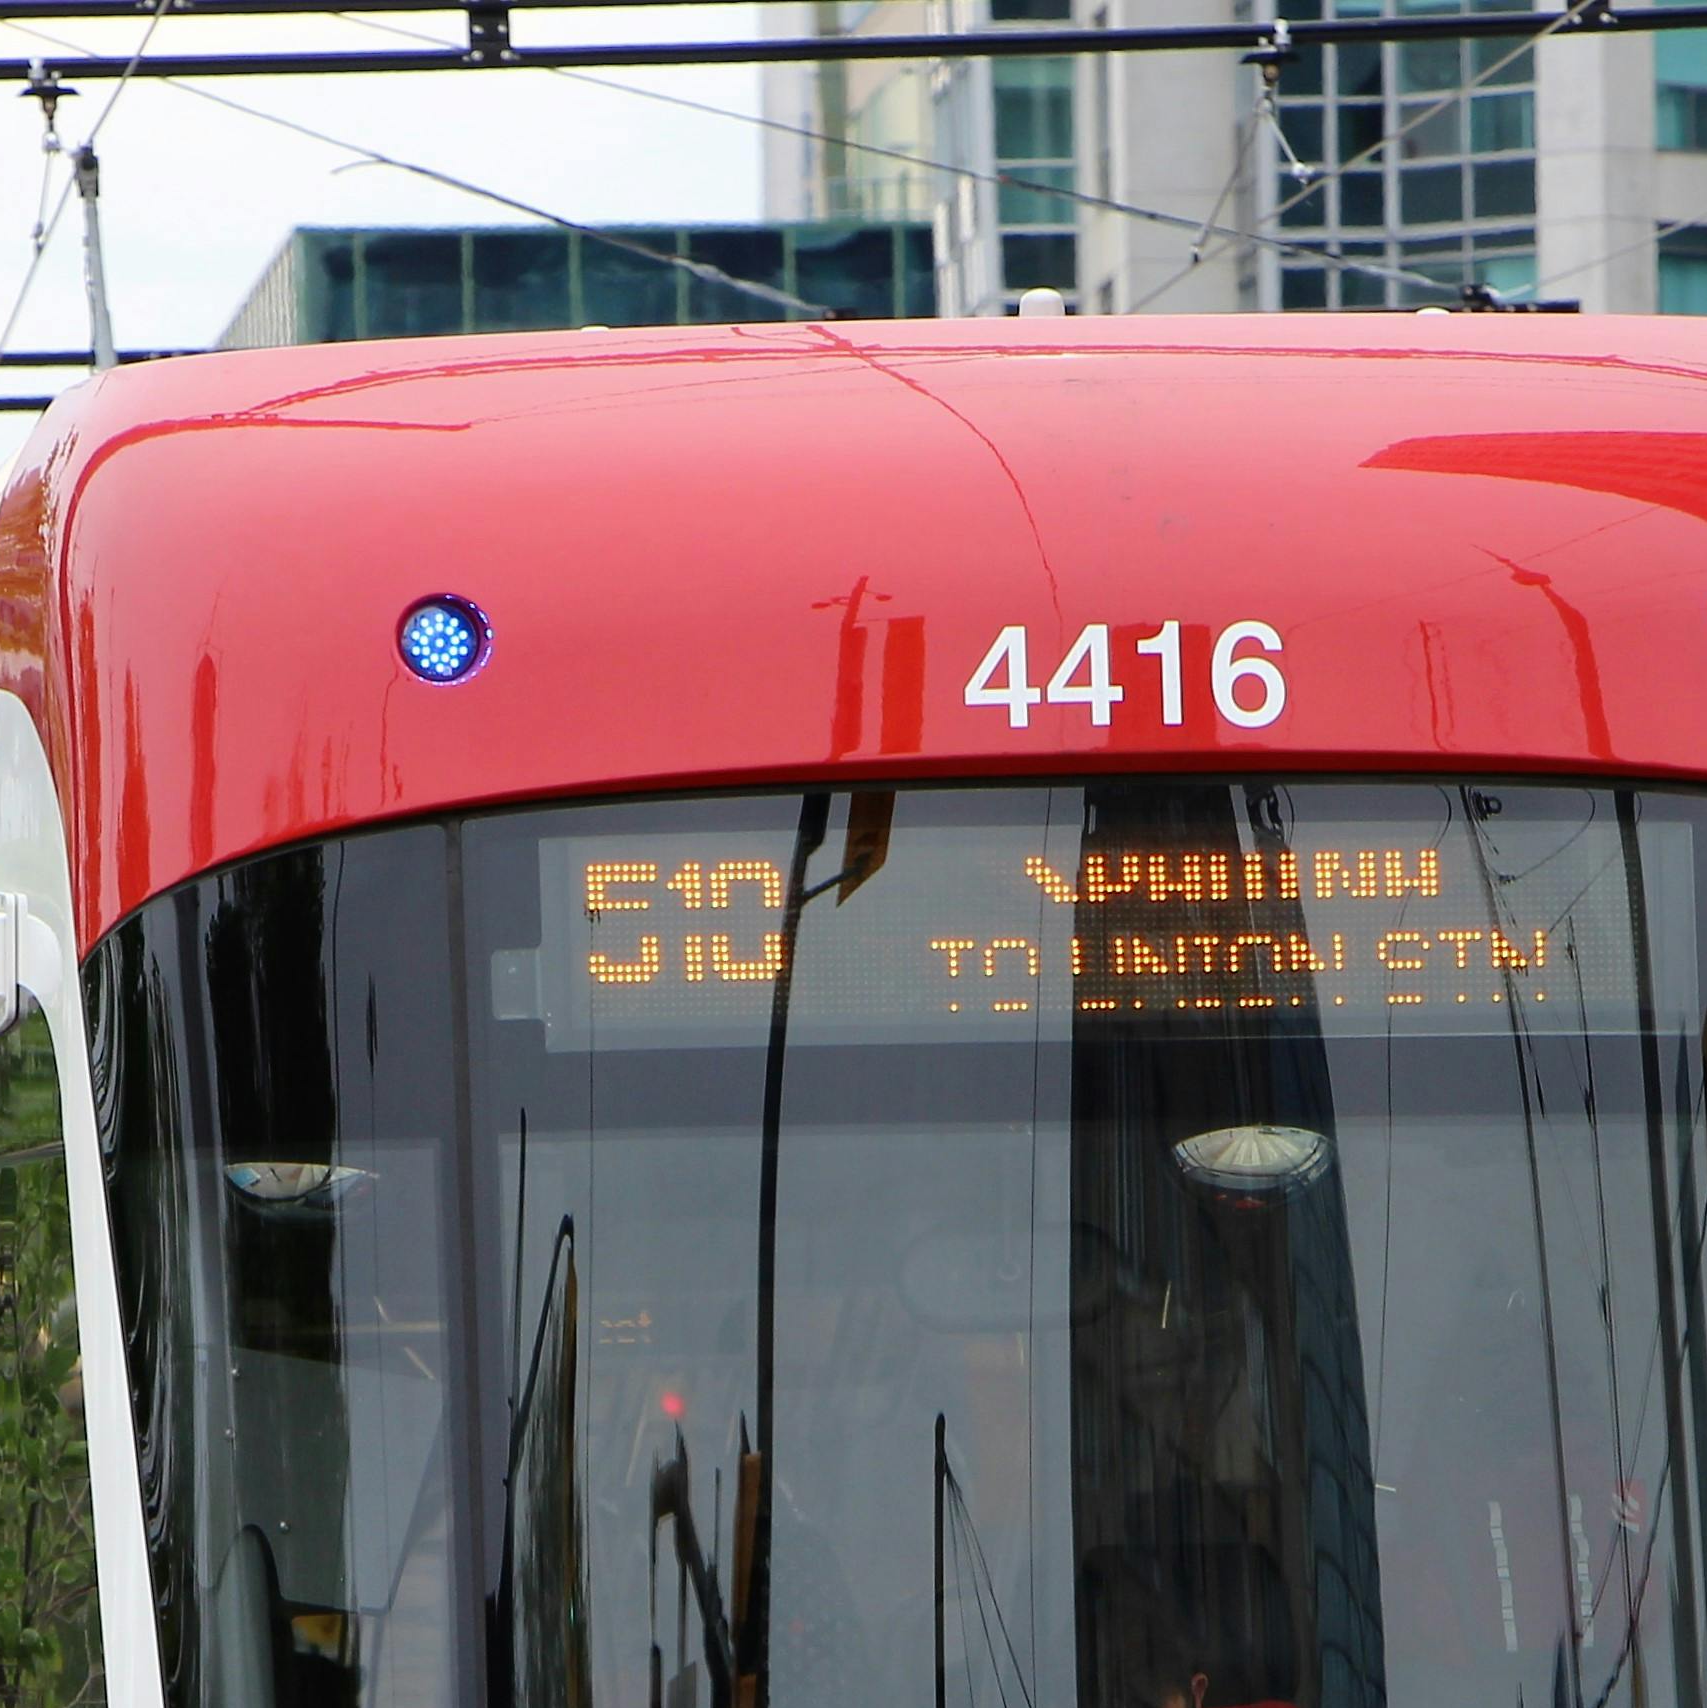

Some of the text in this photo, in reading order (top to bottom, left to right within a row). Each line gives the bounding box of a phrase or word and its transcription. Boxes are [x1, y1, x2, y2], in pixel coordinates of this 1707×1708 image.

[963, 619, 1287, 729] 4416
[586, 861, 783, 983] 510
[930, 936, 1039, 1012] TO
